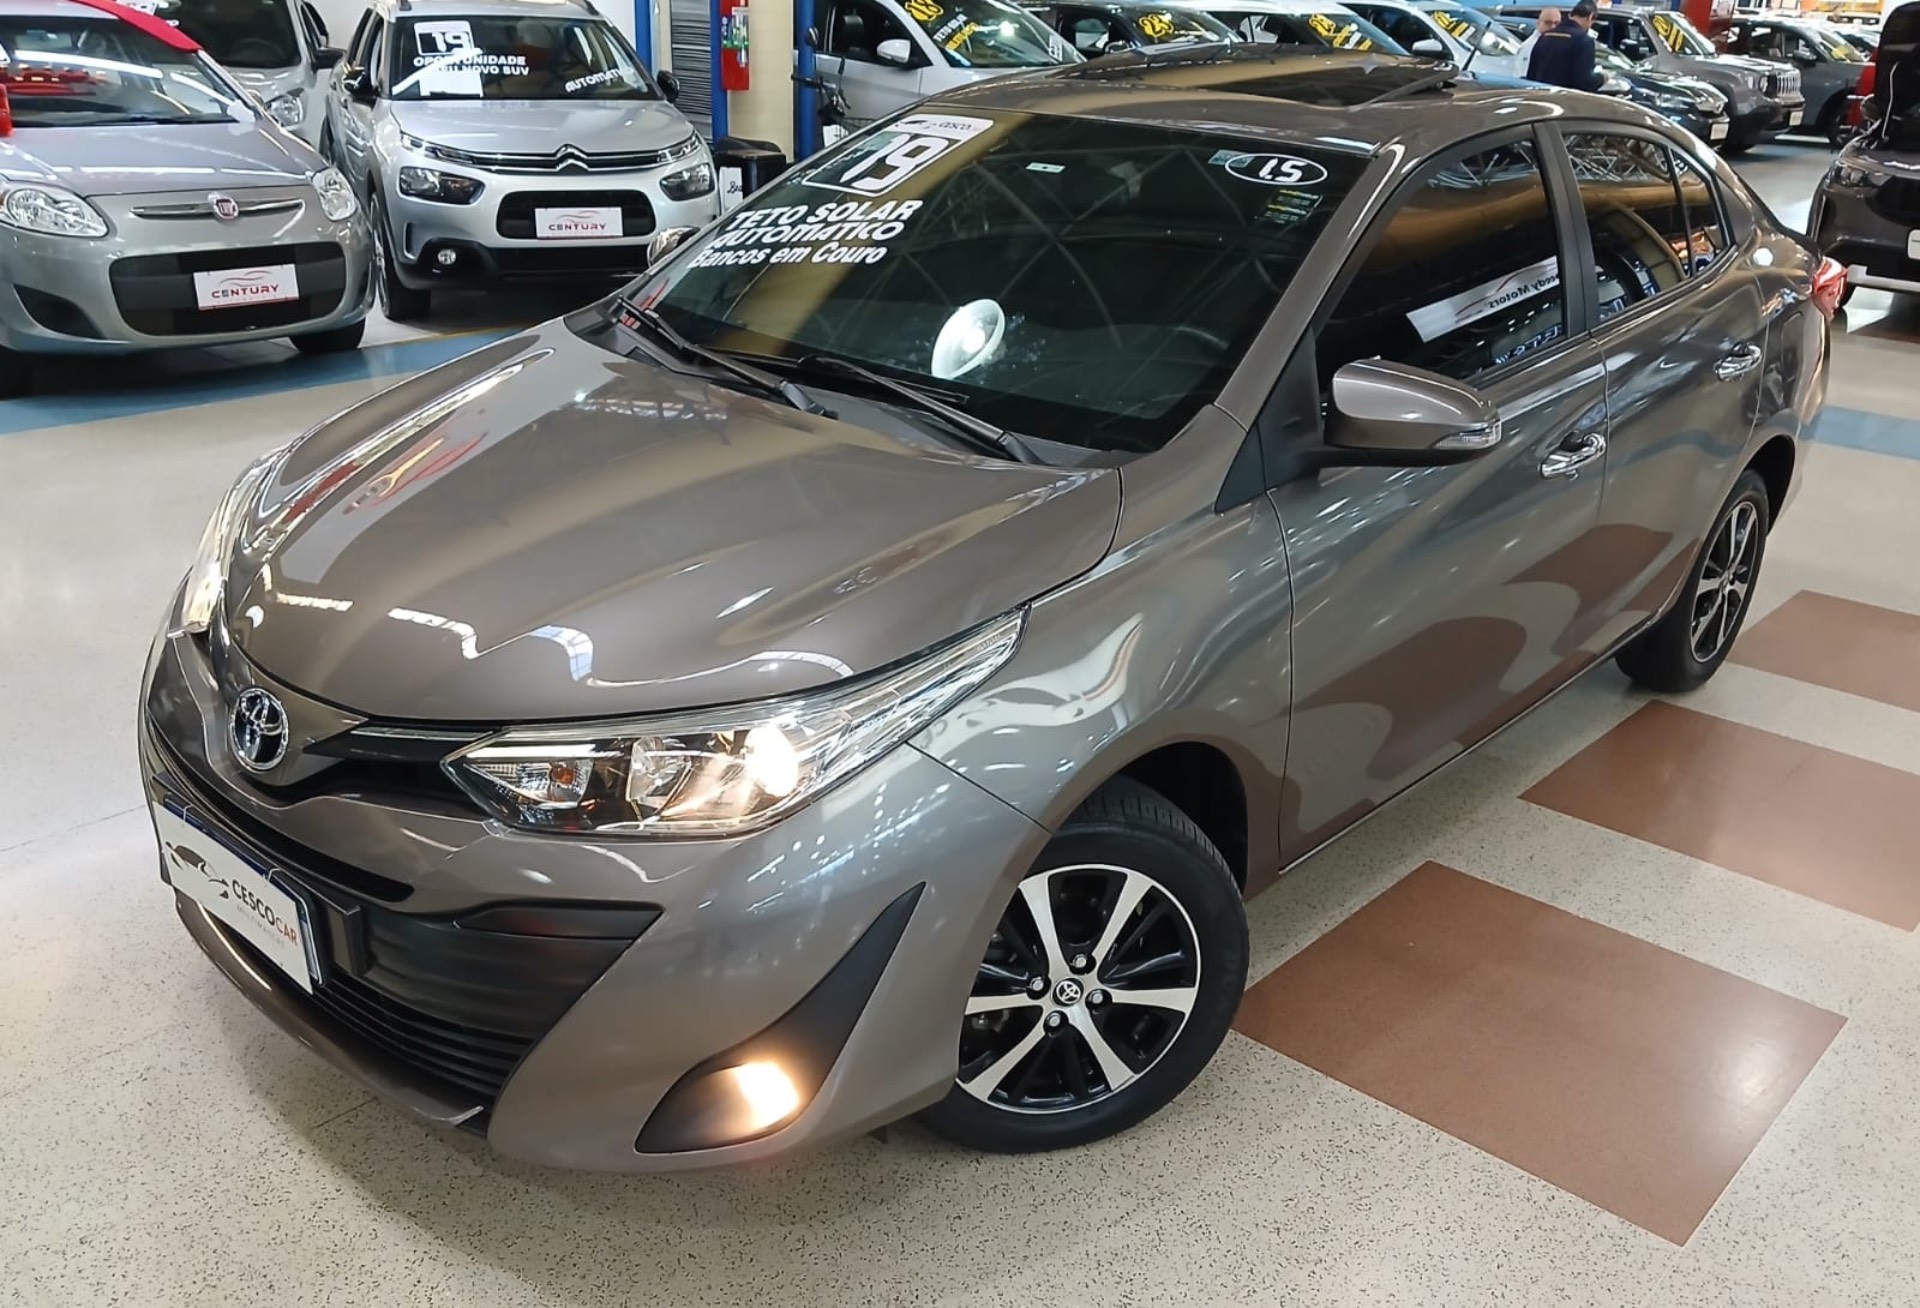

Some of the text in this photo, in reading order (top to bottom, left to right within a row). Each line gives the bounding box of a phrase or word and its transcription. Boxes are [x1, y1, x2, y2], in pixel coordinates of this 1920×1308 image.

[431, 32, 471, 53] 19
[840, 131, 949, 190] 19
[1258, 157, 1308, 182] 1.5
[547, 222, 607, 232] CENTURY
[726, 200, 924, 231] TETO SOLAR
[705, 221, 905, 250] AUTOMATICO
[686, 241, 888, 270] Bancos em Couro
[211, 284, 280, 299] CENTURY
